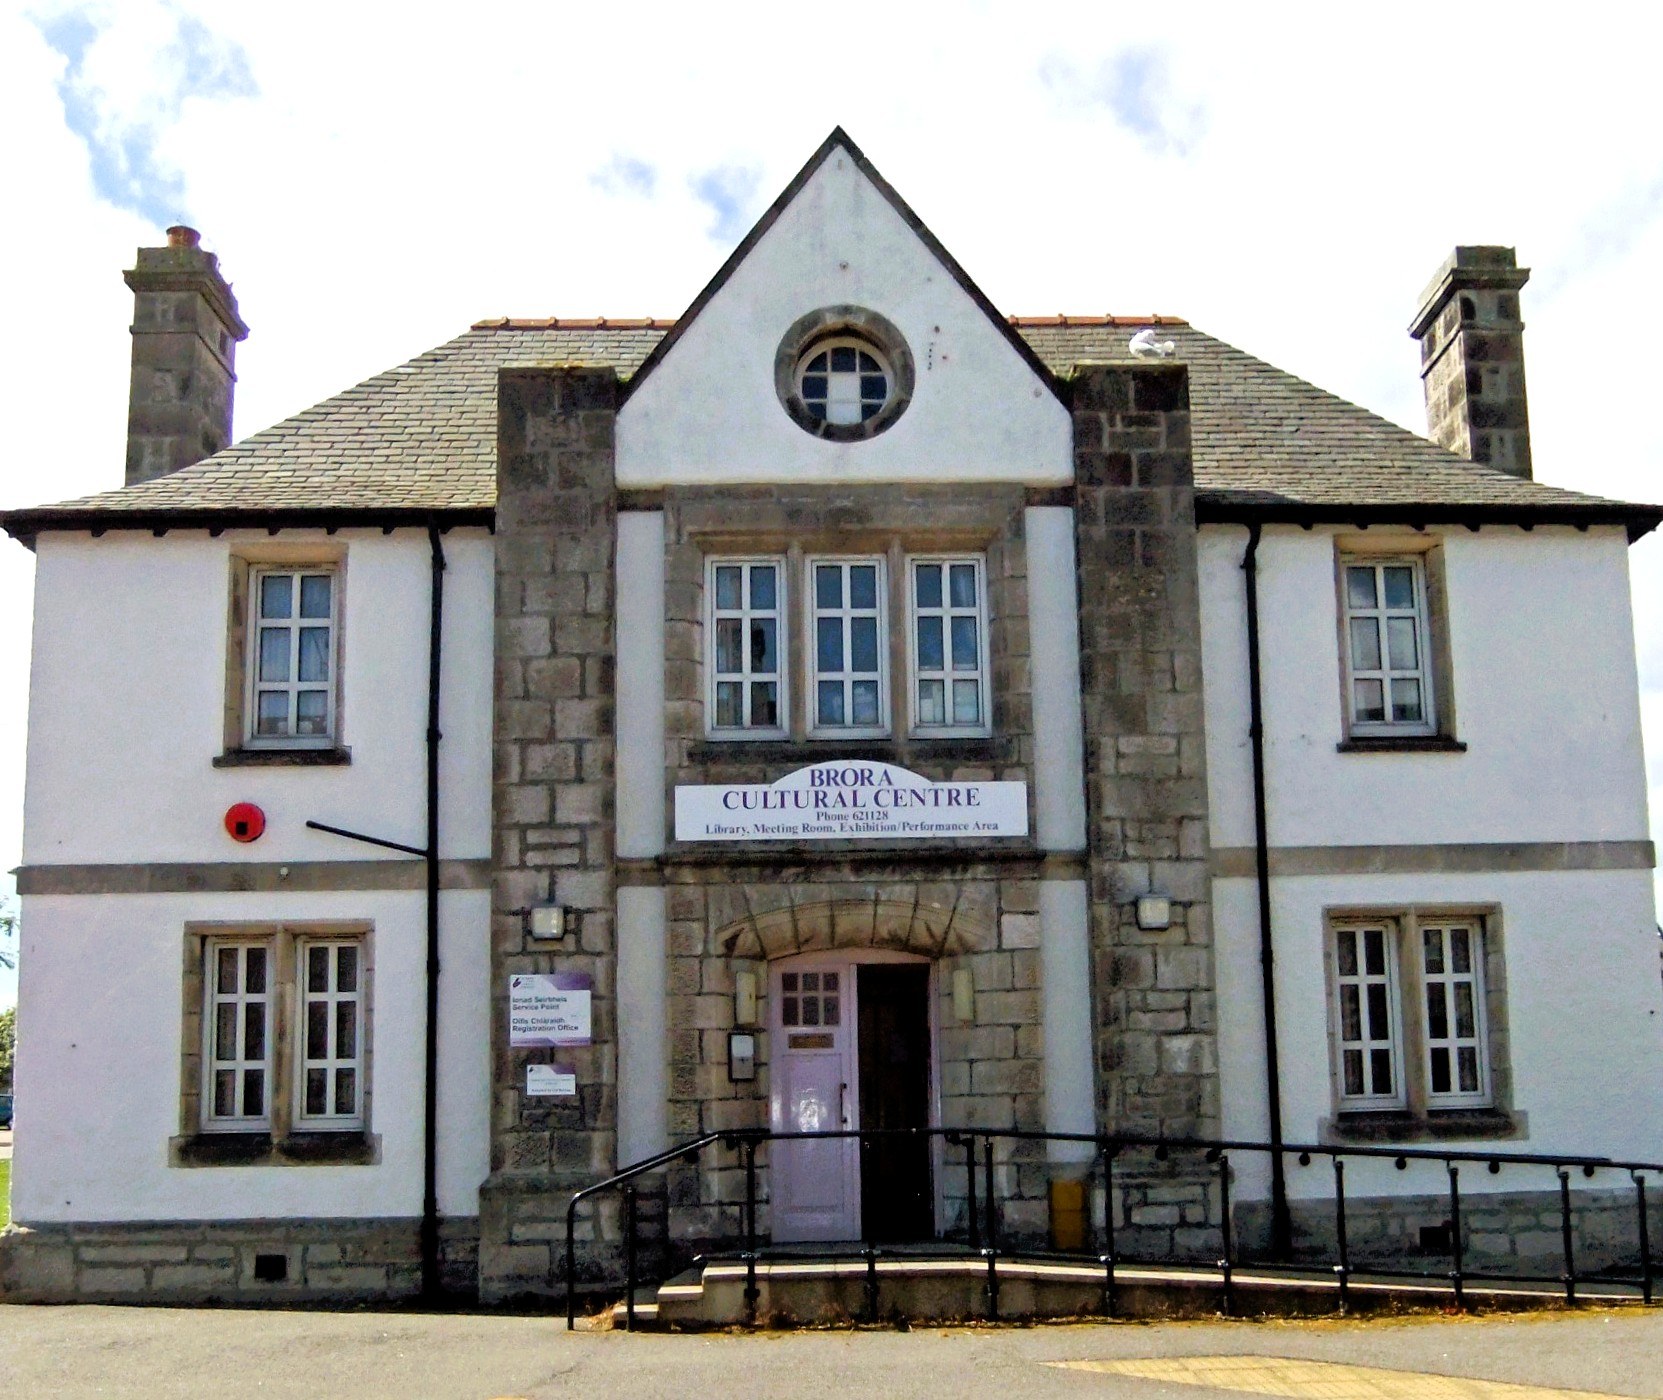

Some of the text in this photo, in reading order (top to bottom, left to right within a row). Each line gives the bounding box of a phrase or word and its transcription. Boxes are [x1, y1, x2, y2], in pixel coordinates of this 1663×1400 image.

[810, 768, 893, 788] BRORA
[722, 787, 981, 810] CULTURAL CENTRE
[816, 811, 889, 822] Phone 621128
[753, 823, 799, 835] Meeting
[972, 820, 999, 831] Area
[512, 1025, 556, 1033] Registration
